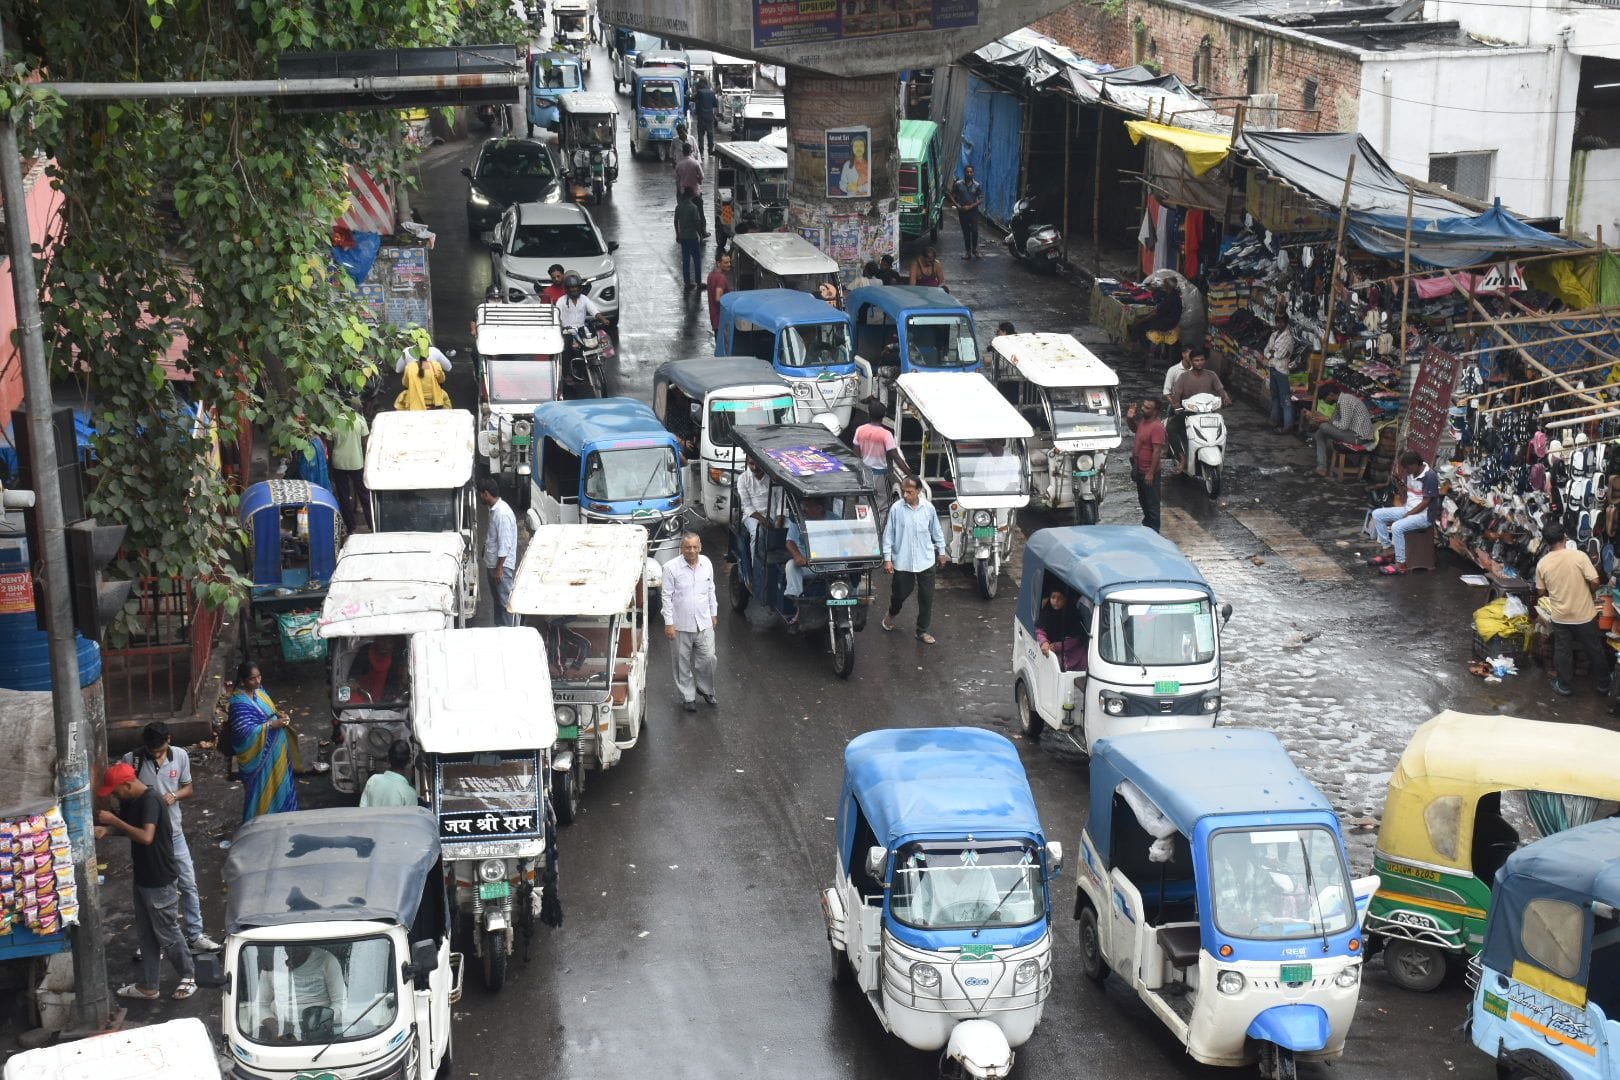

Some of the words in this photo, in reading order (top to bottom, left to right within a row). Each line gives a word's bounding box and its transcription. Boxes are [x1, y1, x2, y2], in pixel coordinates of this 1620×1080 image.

[444, 820, 472, 833] जय
[476, 813, 500, 832] श्री
[503, 815, 532, 832] राम
